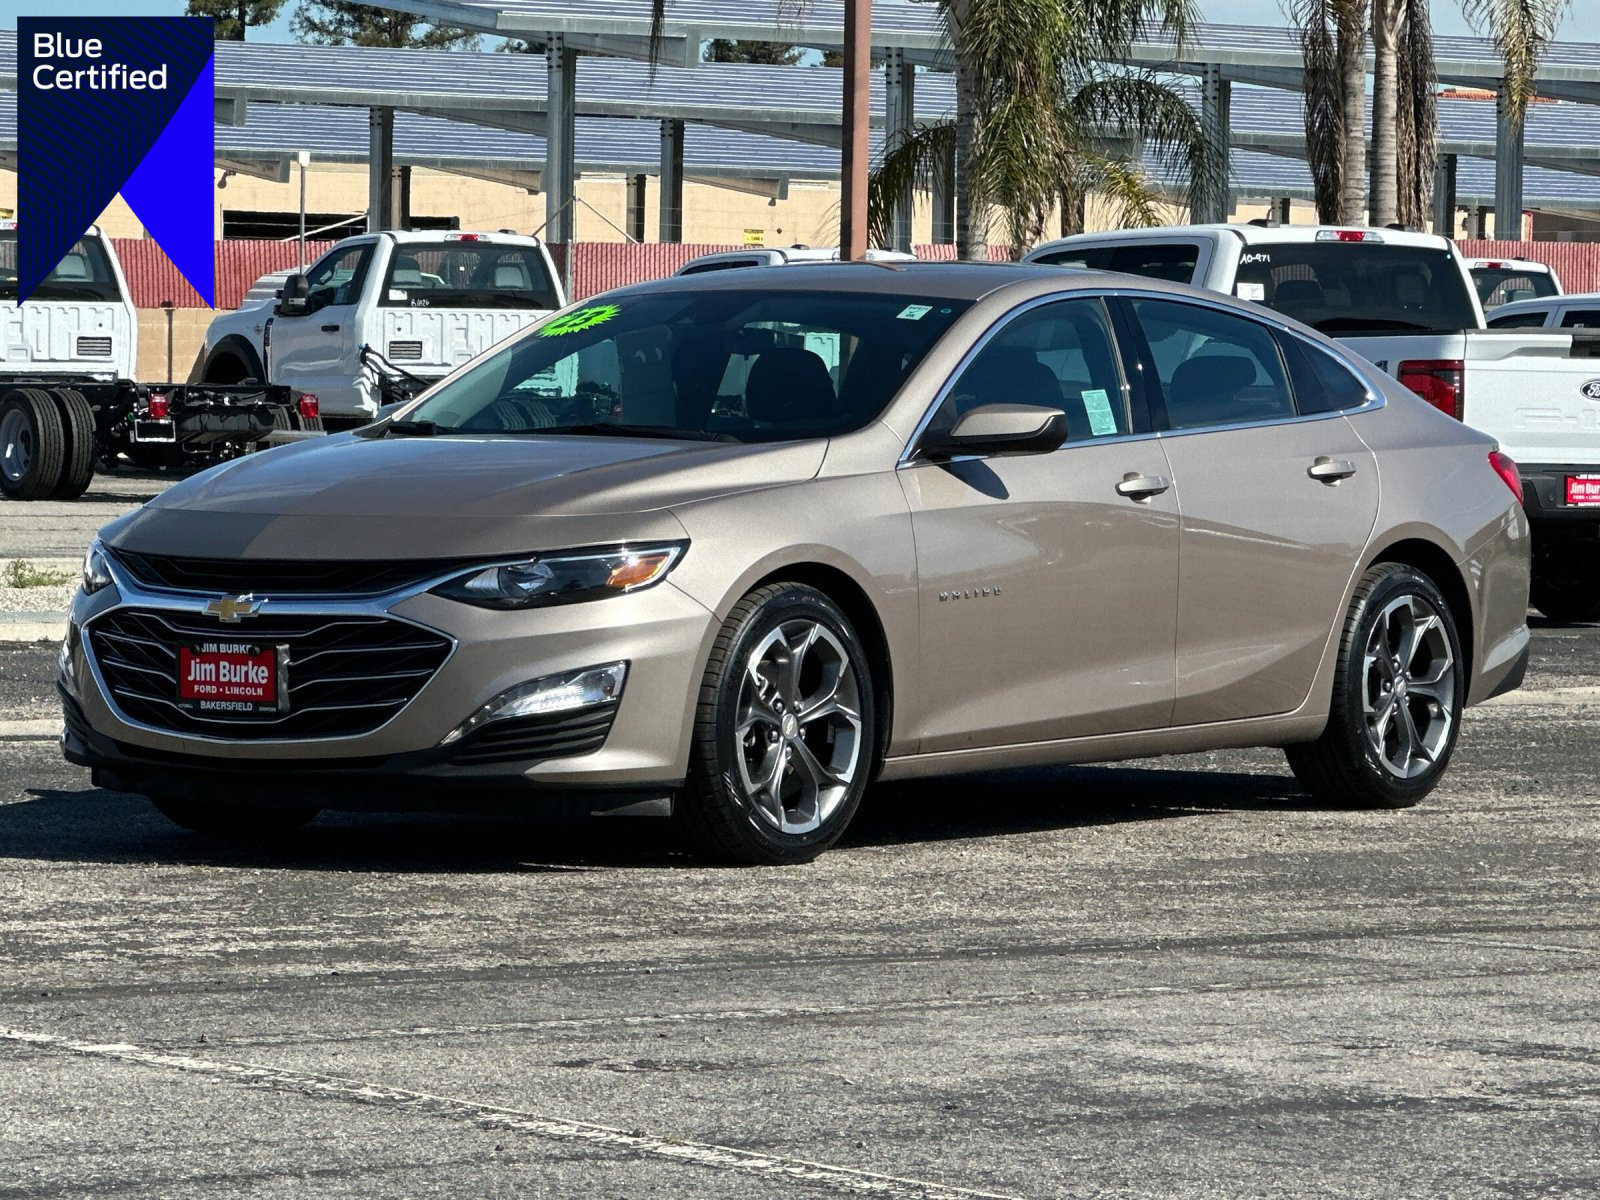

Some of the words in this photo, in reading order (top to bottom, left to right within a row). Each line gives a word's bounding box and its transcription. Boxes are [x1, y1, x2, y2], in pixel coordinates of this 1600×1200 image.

[938, 586, 1002, 602] MALIBU
[201, 643, 218, 653] JIM
[187, 658, 216, 682] Jim
[219, 660, 269, 685] Burke
[193, 684, 218, 694] FORD
[224, 686, 264, 697] LINCOLN
[200, 700, 253, 712] BAKERSFIELD
